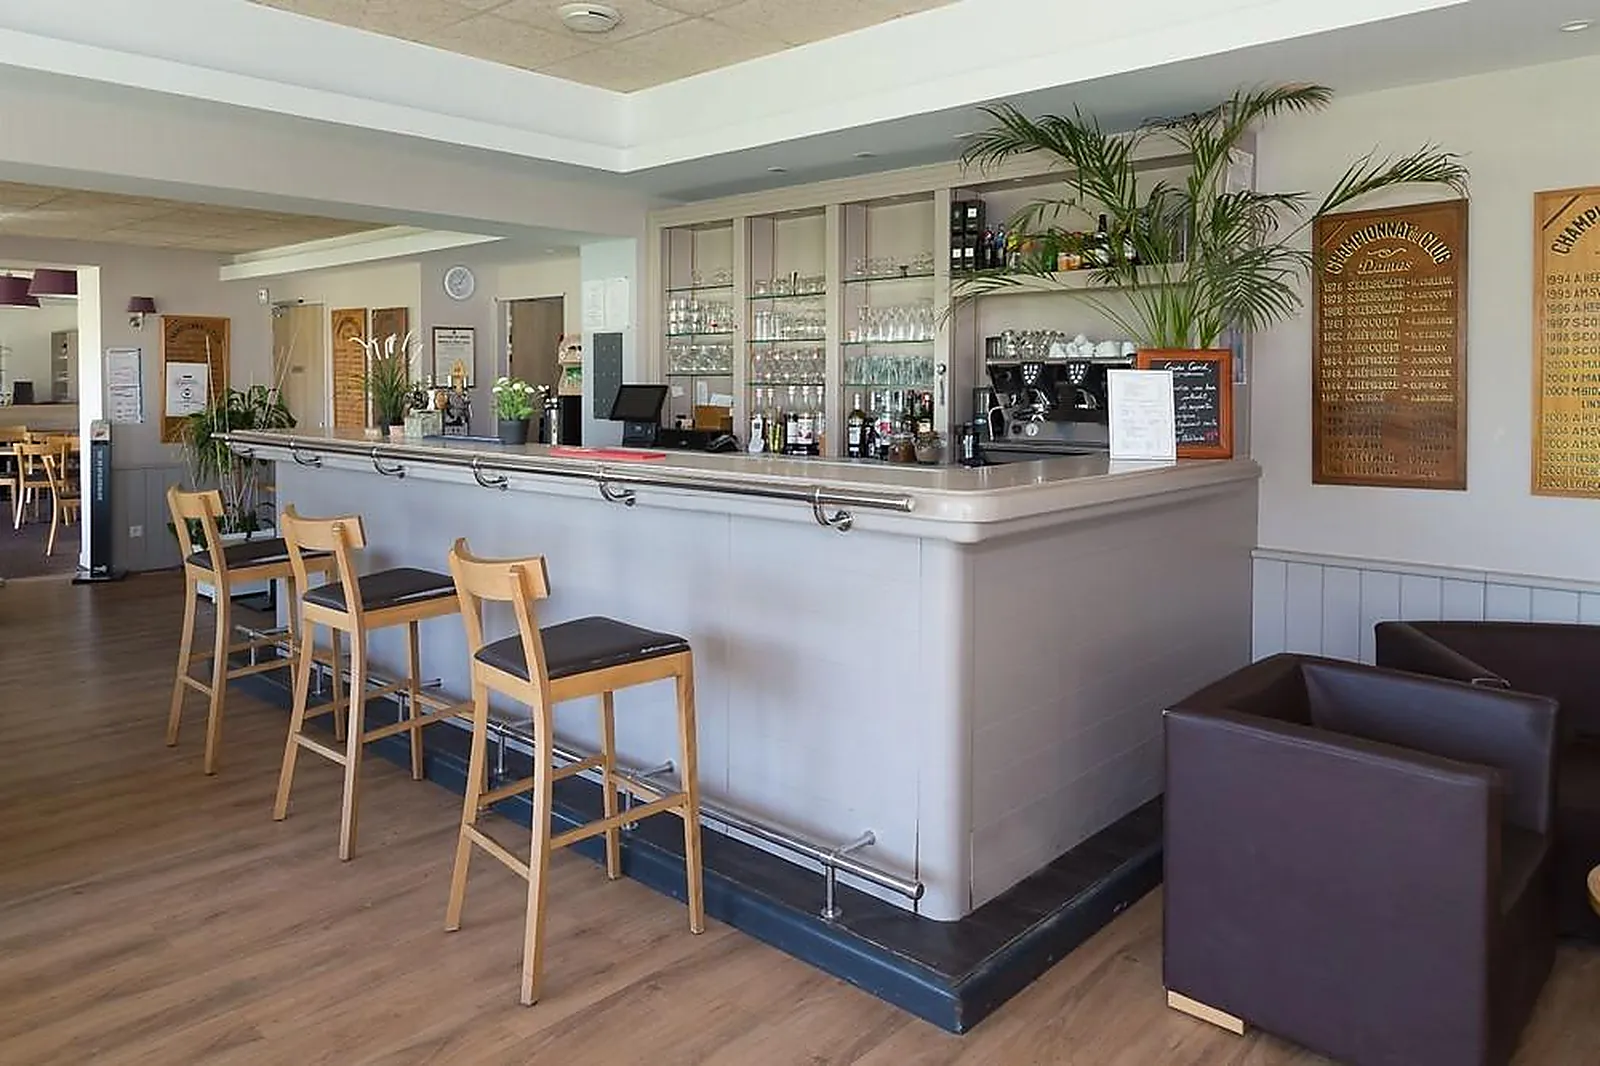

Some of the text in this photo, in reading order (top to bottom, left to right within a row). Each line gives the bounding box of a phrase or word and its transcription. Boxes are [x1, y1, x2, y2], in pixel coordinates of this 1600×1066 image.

[1324, 221, 1411, 275] CHAMPIONNAT
[1418, 231, 1452, 265] CLUB
[1357, 259, 1412, 275] Dames
